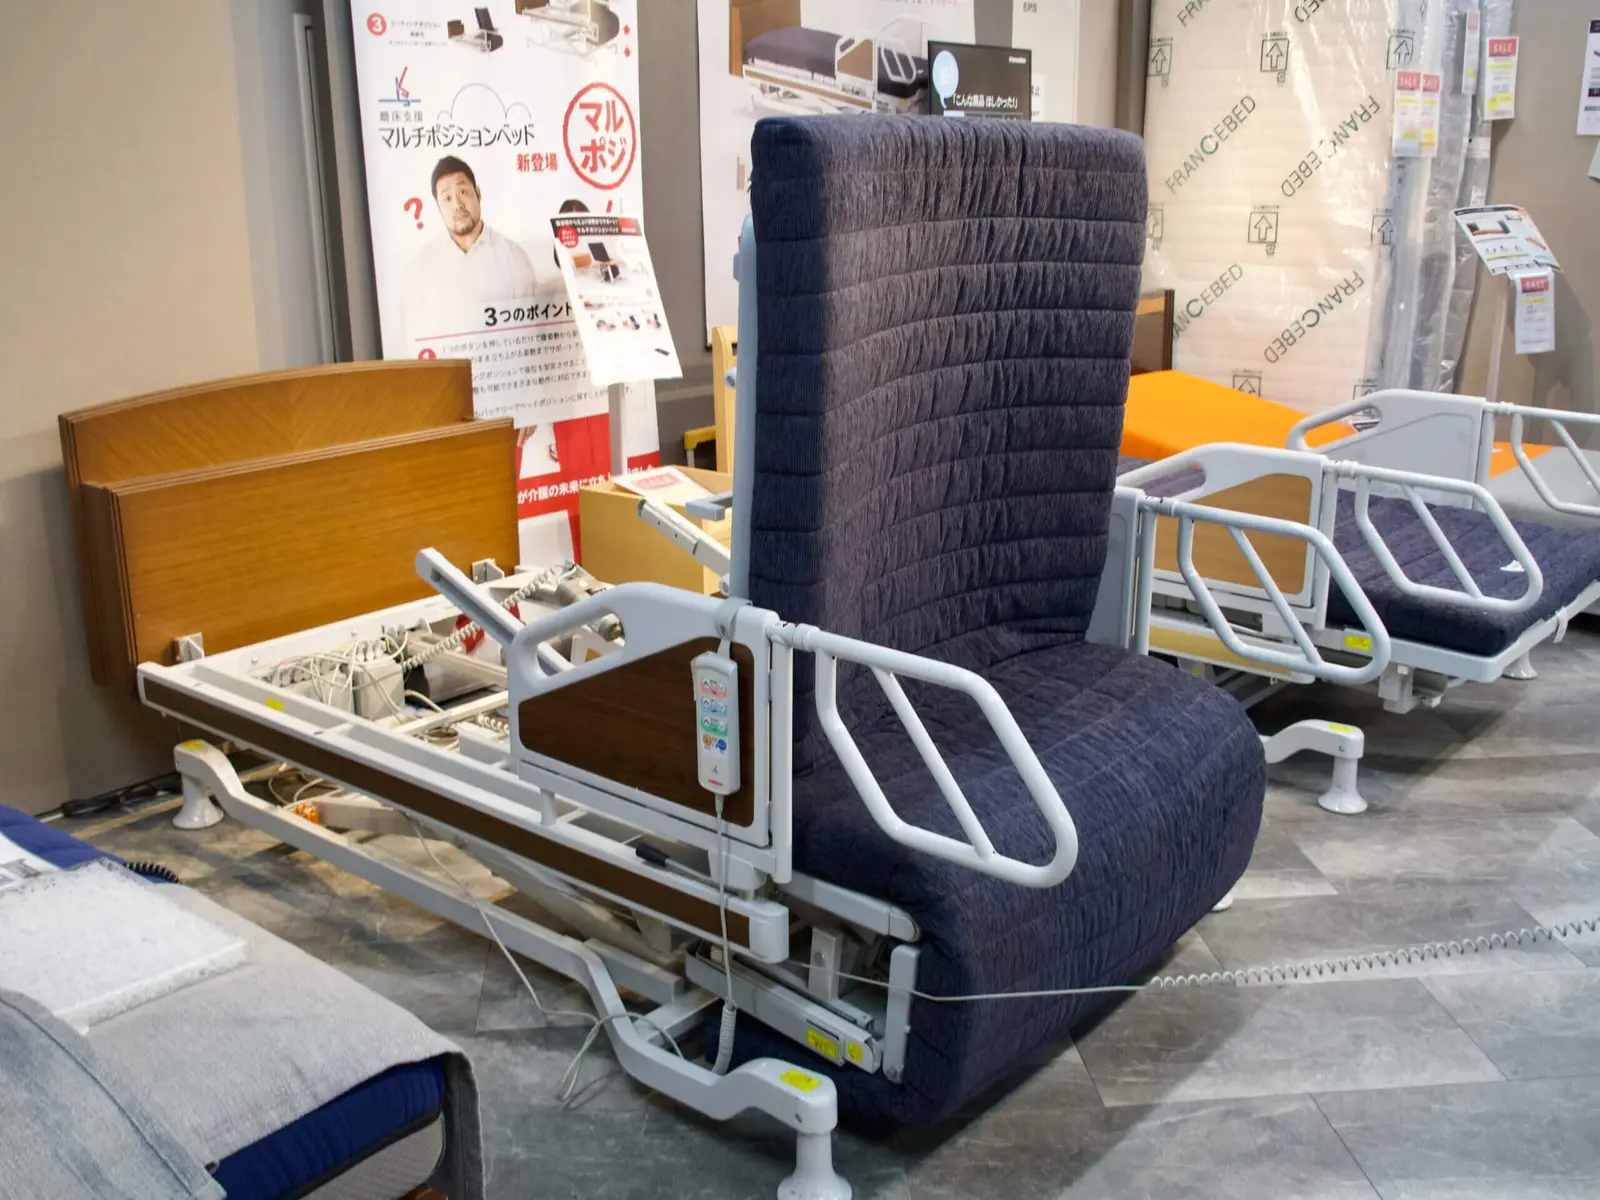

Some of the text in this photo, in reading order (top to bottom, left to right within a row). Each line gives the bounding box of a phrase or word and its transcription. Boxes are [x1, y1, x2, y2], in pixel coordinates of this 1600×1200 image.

[579, 99, 624, 133] マル
[378, 122, 535, 149] マルチポジションベッド
[1165, 95, 1256, 195] FRANCEBED
[516, 152, 559, 172] 新登場
[580, 136, 628, 173] ポジ
[484, 301, 572, 327] 3つのポイント
[1263, 270, 1365, 364] FRANCEBED
